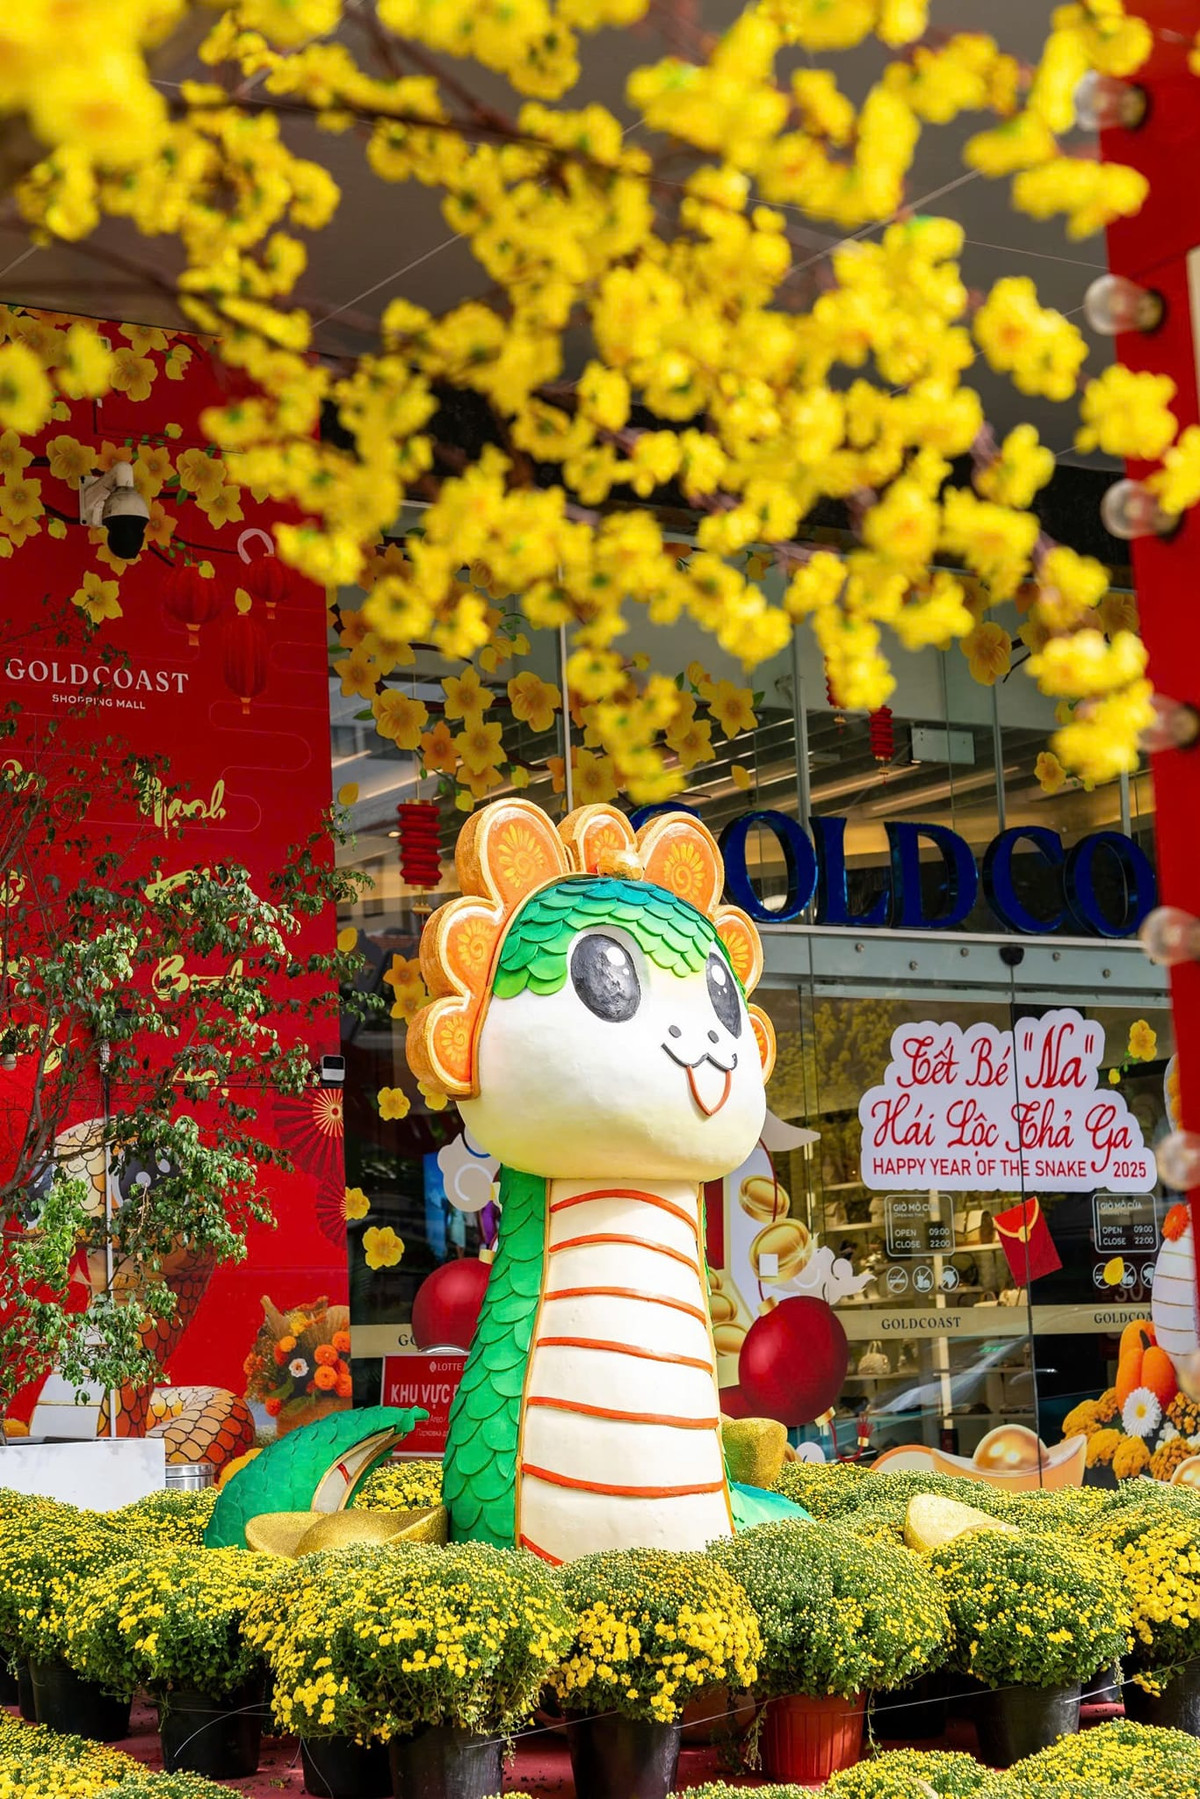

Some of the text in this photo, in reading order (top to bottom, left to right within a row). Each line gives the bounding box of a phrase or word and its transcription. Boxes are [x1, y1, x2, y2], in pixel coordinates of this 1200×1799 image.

[5, 658, 189, 693] GOLDCOAST
[52, 694, 146, 710] SHOPPING MALL
[629, 801, 1158, 938] OLDCO
[896, 1022, 1094, 1089] Tết Bé "Na"
[870, 1093, 1133, 1173] Hái Lộc Thả Ga
[872, 1157, 1147, 1178] HAPPY YEAR OF THE SNAKE 2025
[894, 1227, 950, 1237] OPEN 09:00
[1102, 1225, 1154, 1234] OPEN 09:00
[895, 1239, 951, 1249] CLOSE 22:00
[1102, 1236, 1154, 1246] CLOSE 22:00
[881, 1316, 961, 1330] GOLDCOAST
[437, 1362, 462, 1371] LOTTE
[391, 1384, 419, 1403] KHU
[421, 1383, 451, 1409] VỰC
